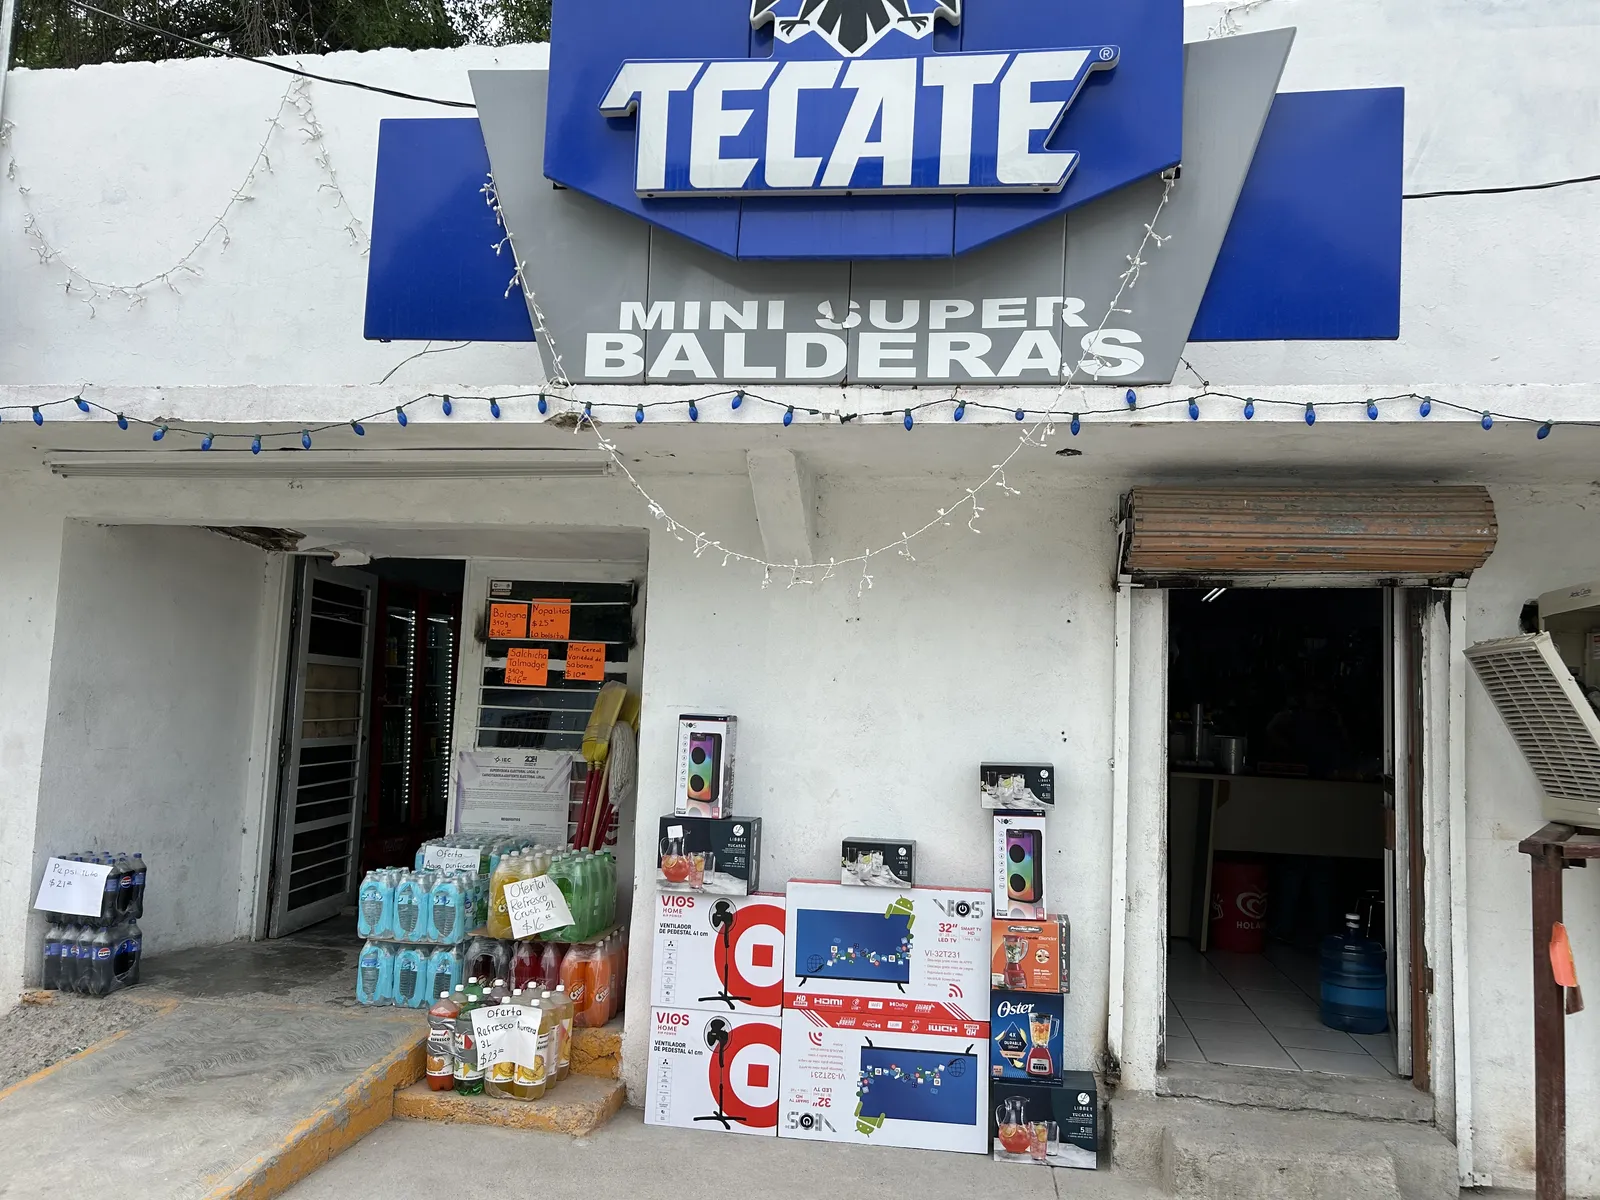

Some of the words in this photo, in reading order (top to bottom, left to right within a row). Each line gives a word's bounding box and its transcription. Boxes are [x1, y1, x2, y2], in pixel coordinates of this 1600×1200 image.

[599, 49, 1092, 190] TECATE
[619, 301, 784, 331] MINI
[815, 296, 1088, 330] SUPER
[584, 328, 1145, 379] BALDERAS
[493, 607, 527, 621] Bologna
[533, 604, 570, 616] Nopalitos
[510, 648, 547, 660] Salchicha
[568, 644, 581, 652] Mini
[437, 849, 463, 858] Oferta
[53, 863, 76, 876] Pepsi
[510, 895, 548, 912] Refresco
[661, 895, 694, 908] VIOS
[514, 906, 541, 920] Crush
[932, 899, 984, 919] VIOS
[924, 950, 960, 958] VI-32T231
[796, 994, 806, 1002] HD
[814, 998, 843, 1006] HDMI
[487, 1006, 522, 1018] Oferta
[996, 1000, 1035, 1018] Oster
[656, 1012, 690, 1026] VIOS
[476, 1023, 514, 1038] Refresco
[480, 1039, 492, 1049] 3L
[654, 1040, 686, 1048] VENTILADOR
[662, 1046, 686, 1054] PEDESTAL
[811, 1072, 846, 1080] VI-32T231
[787, 1110, 837, 1132] VIOS
